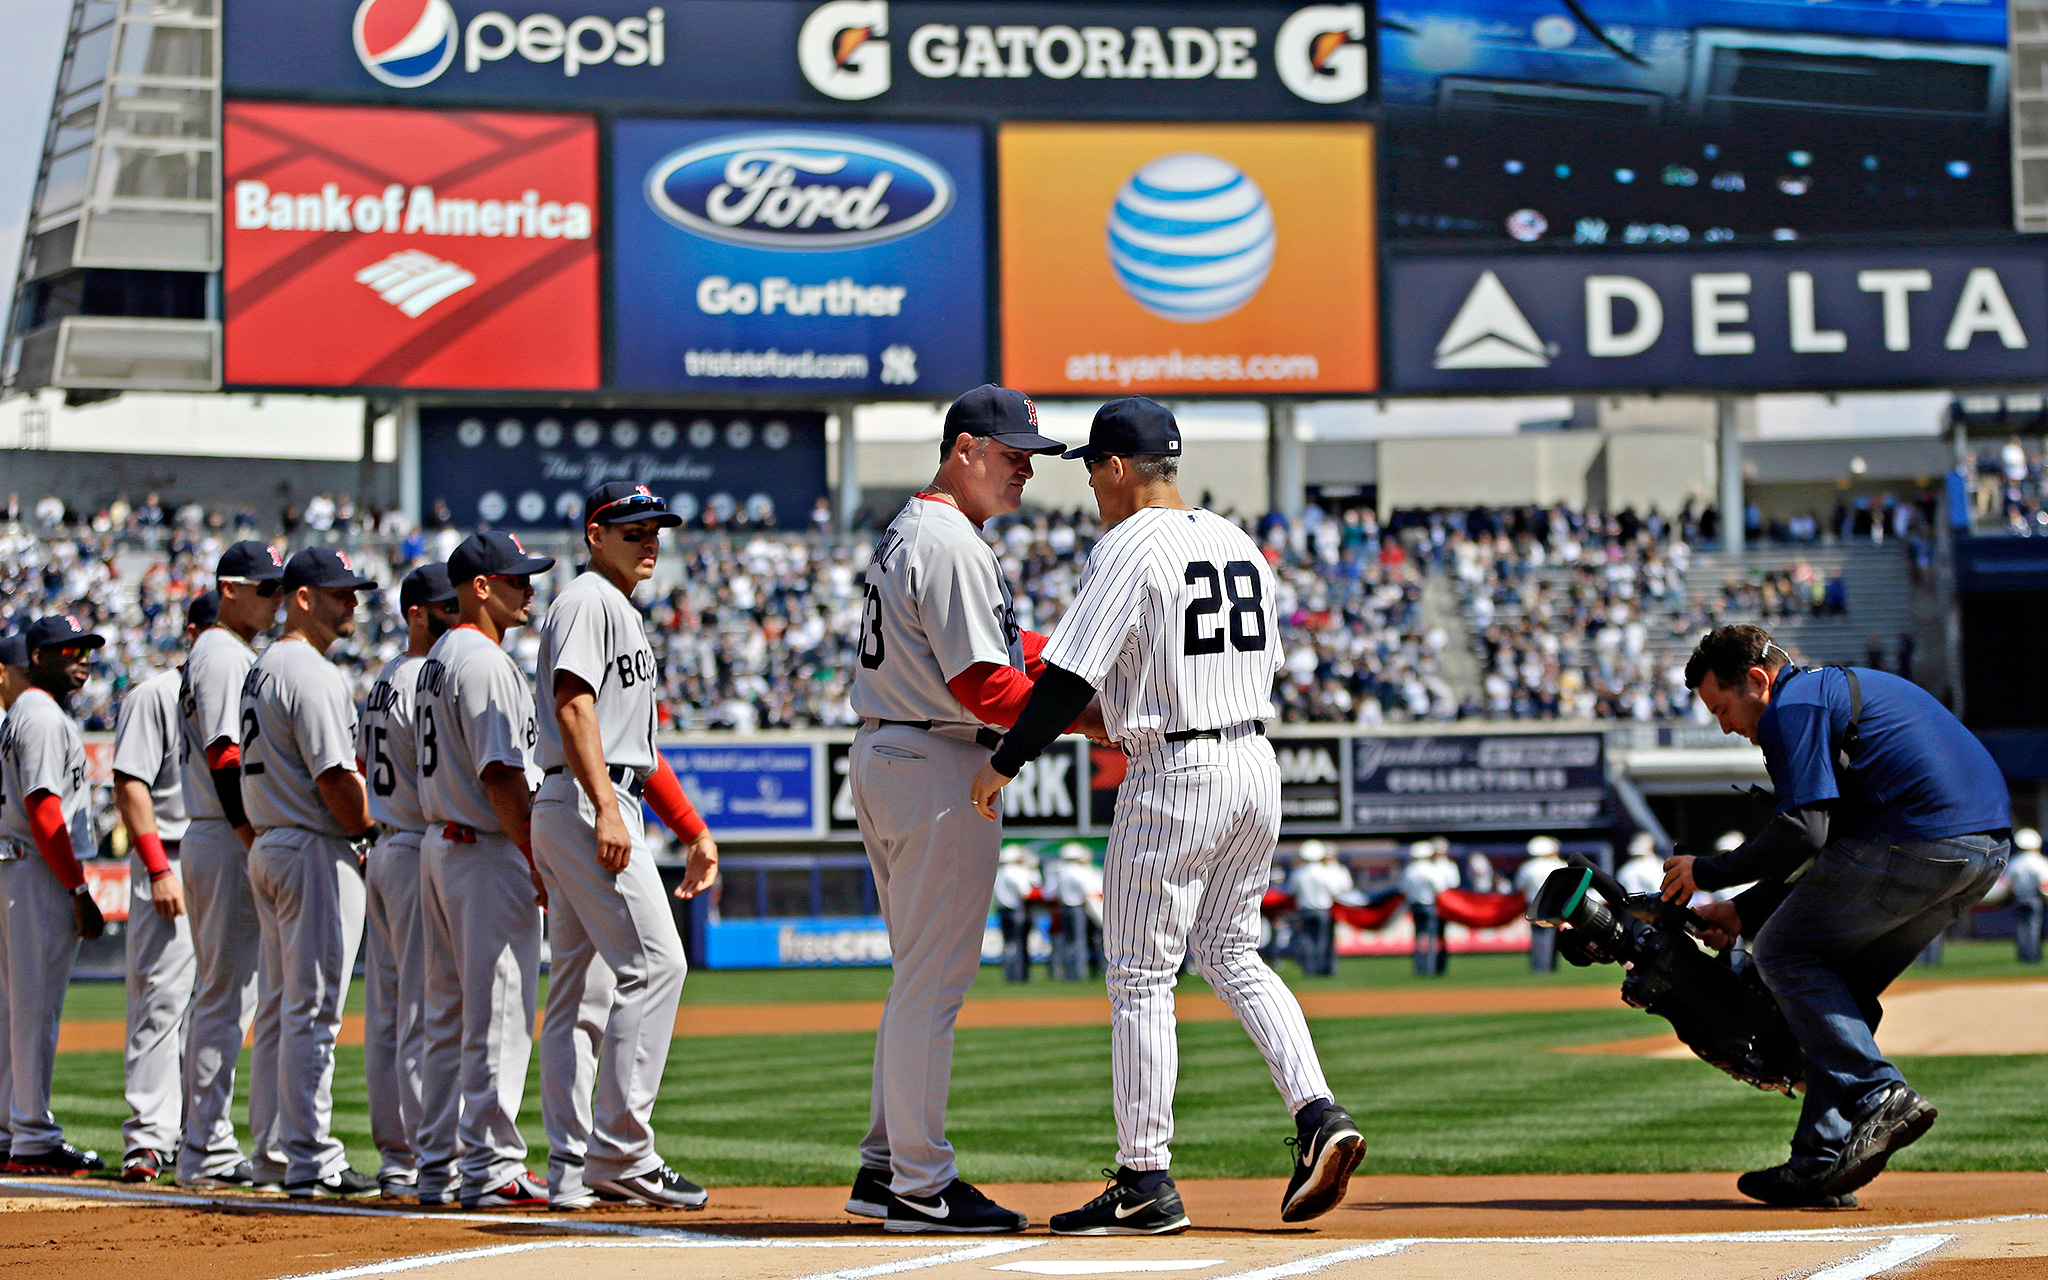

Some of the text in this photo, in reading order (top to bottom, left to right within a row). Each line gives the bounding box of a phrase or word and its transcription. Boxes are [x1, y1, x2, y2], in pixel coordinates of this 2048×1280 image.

[465, 6, 665, 77] pepsi
[908, 23, 1258, 80] GATORADE
[234, 179, 592, 240] Bank of America
[705, 150, 895, 232] Ford
[696, 275, 907, 317] Go Further
[1583, 266, 2029, 358] DELTA
[1184, 561, 1266, 656] 28
